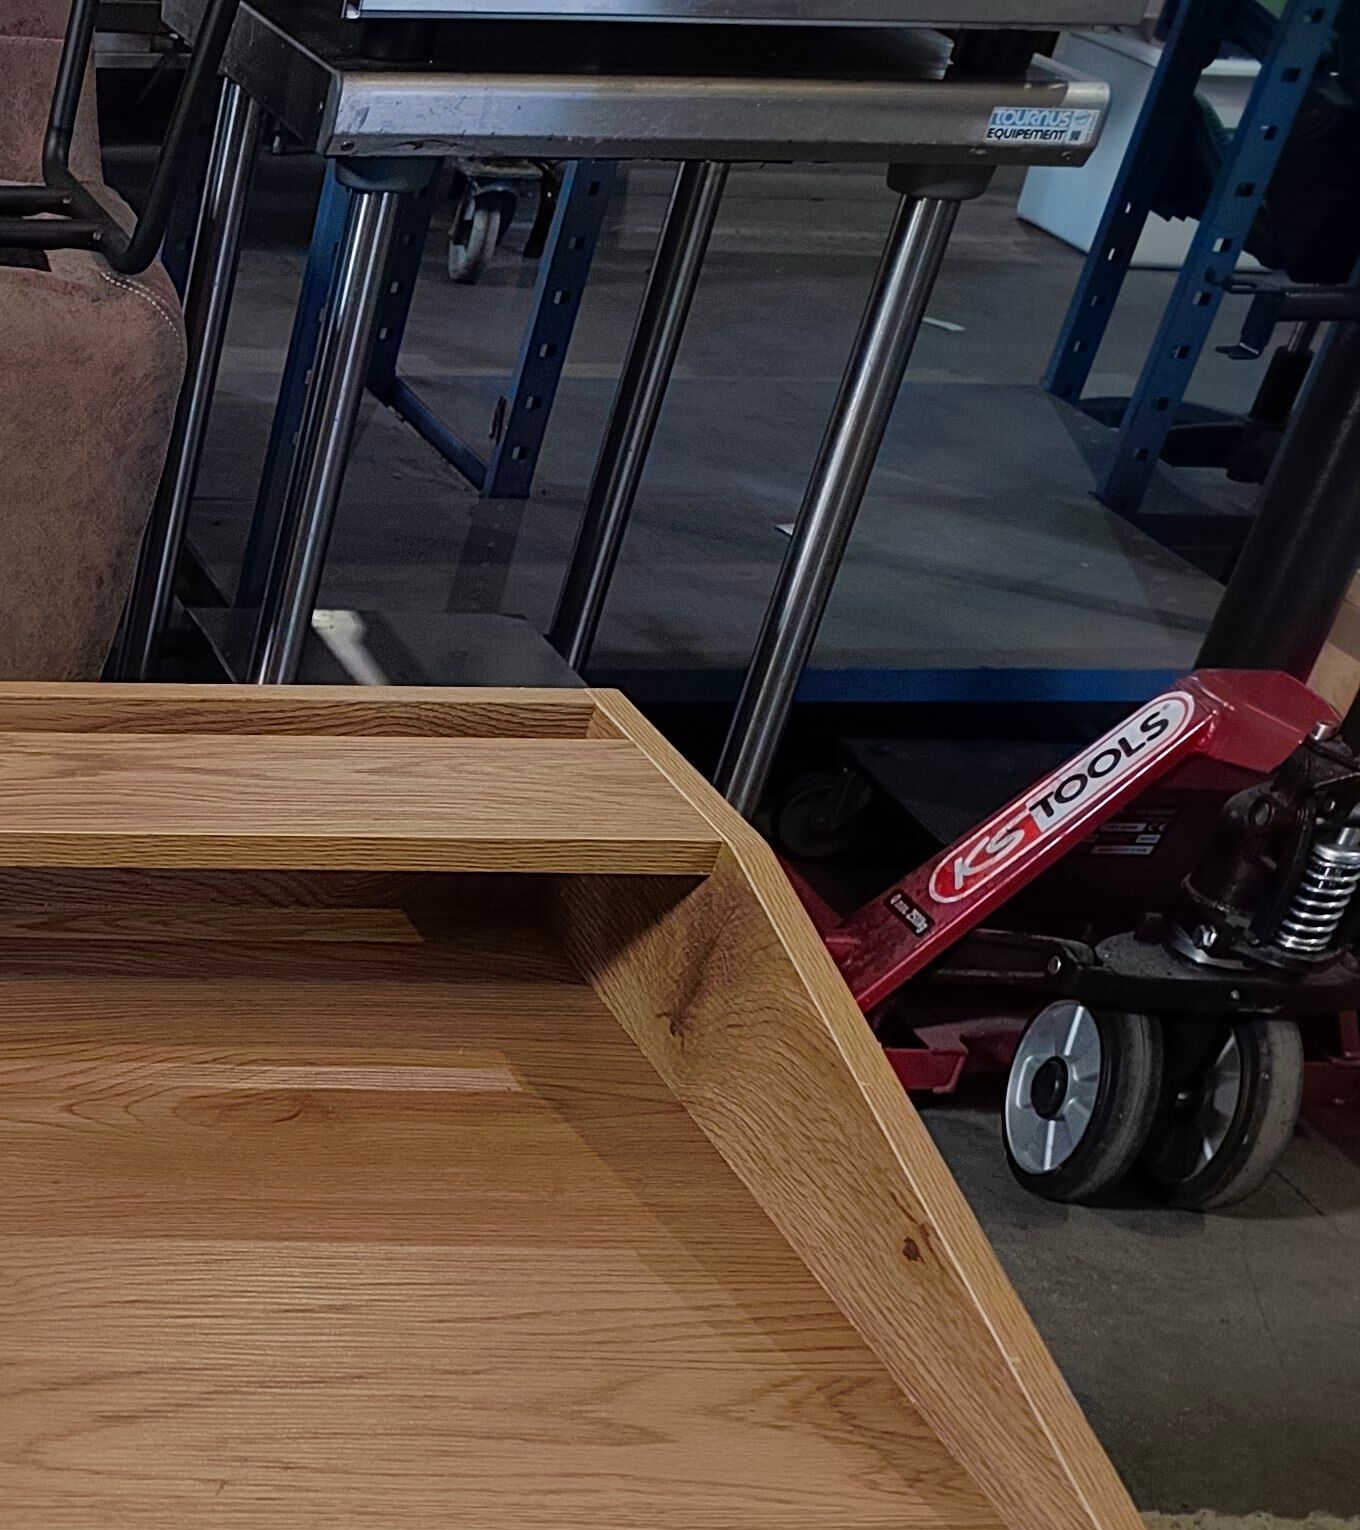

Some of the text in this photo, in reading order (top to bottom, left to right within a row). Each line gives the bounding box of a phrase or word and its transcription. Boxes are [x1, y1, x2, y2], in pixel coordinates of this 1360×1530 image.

[992, 108, 1072, 126] TOURNUS
[986, 127, 1067, 140] EQUIPEMENT
[953, 710, 1170, 890] KS TOOLS
